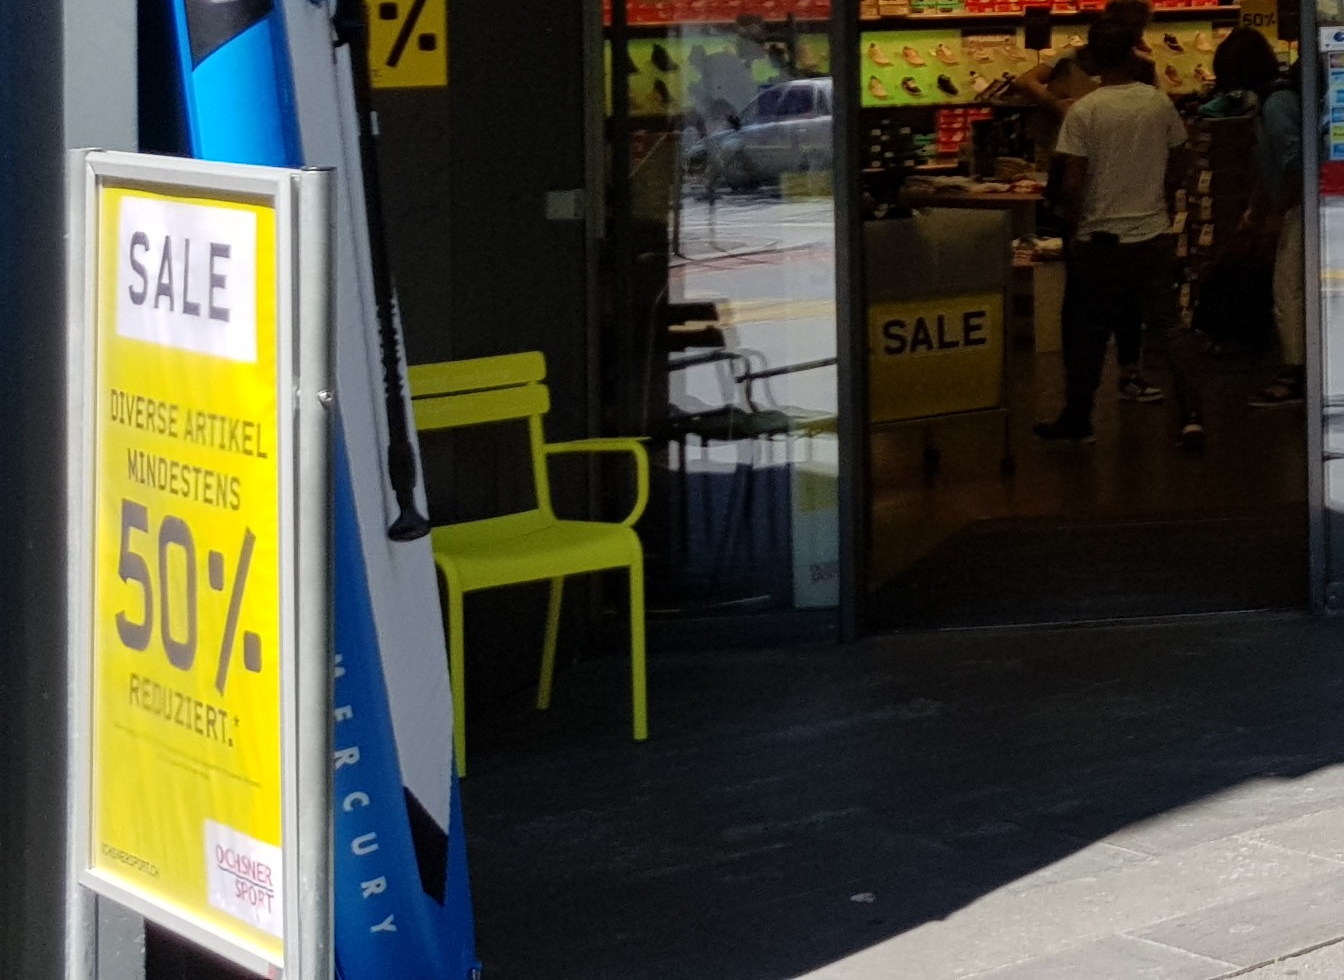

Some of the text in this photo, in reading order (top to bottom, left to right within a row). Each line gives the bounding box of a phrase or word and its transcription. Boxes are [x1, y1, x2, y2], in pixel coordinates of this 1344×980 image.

[128, 231, 232, 323] SALE
[883, 310, 987, 355] SALE
[109, 388, 268, 460] DIVERSE ARTIKEL
[126, 447, 242, 512] MINDESTENS
[115, 498, 262, 698] 50%
[215, 844, 274, 887] OCHSNER
[234, 878, 275, 914] SPORT
